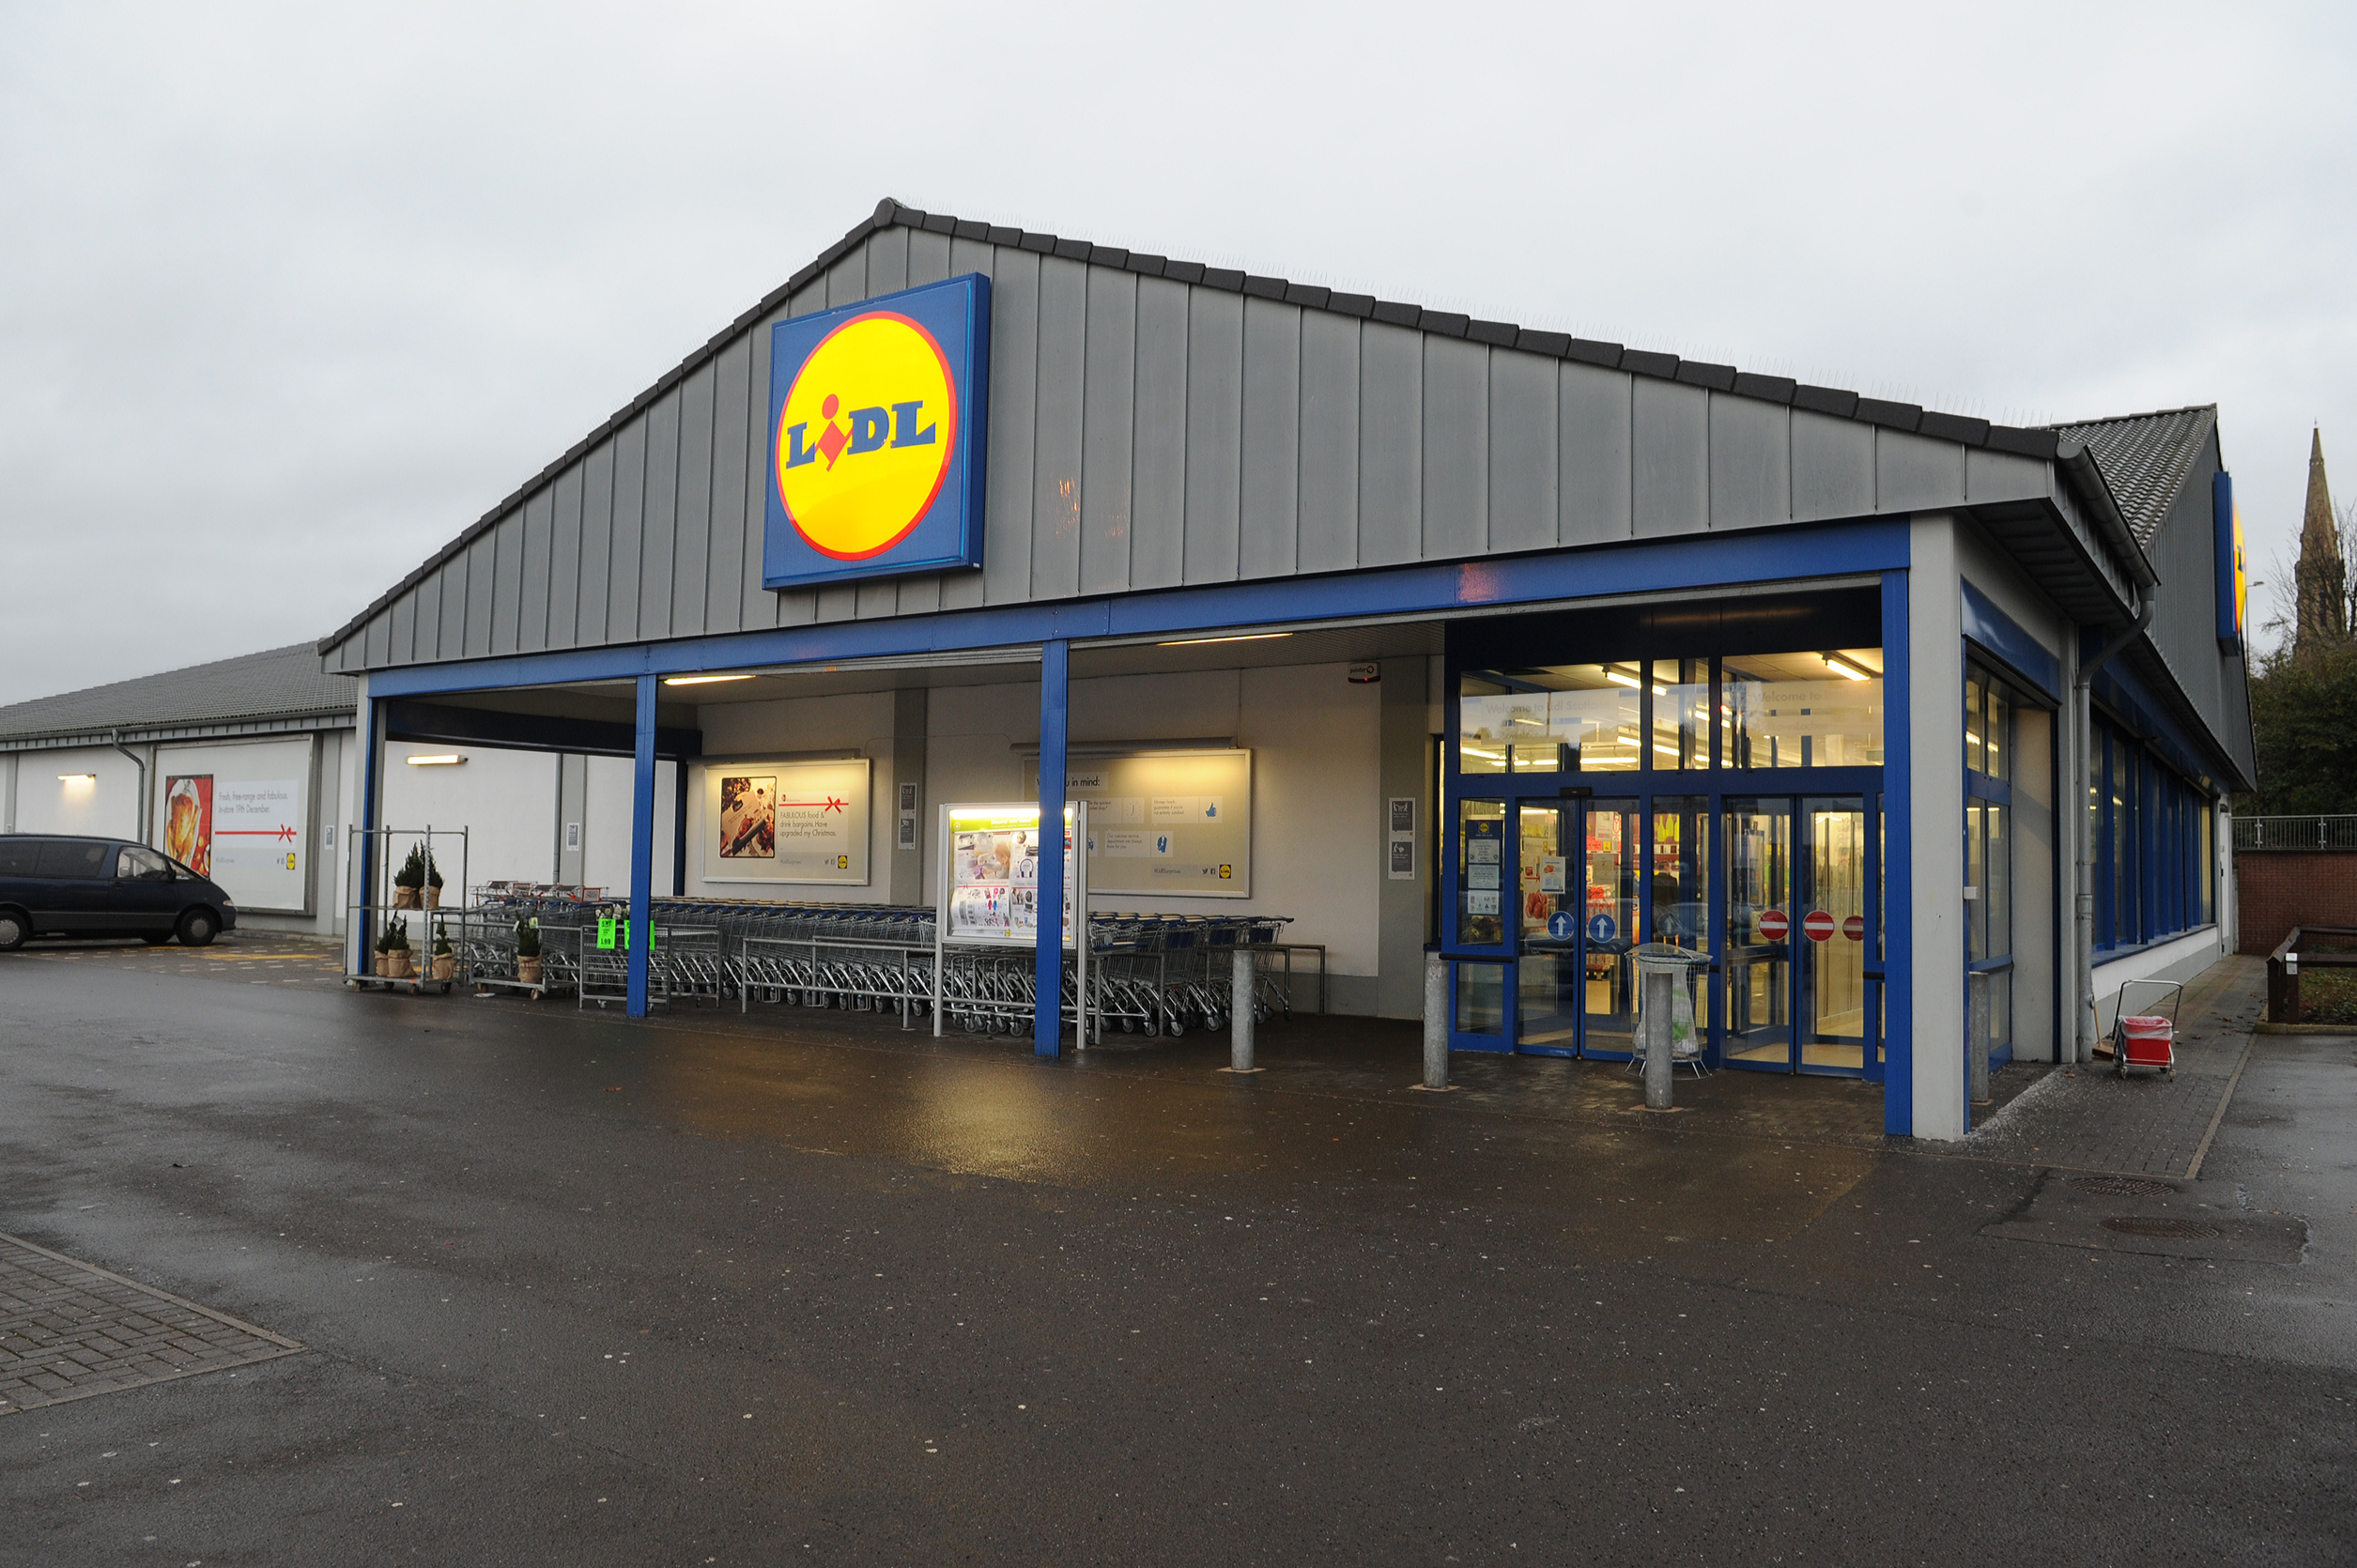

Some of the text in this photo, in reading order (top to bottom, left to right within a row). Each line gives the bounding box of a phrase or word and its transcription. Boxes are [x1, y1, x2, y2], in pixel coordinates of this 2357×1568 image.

[1810, 690, 1822, 700] to
[1487, 704, 1532, 714] Welcome
[1534, 703, 1544, 712] to
[1071, 777, 1079, 787] in
[1080, 776, 1101, 787] mind:
[233, 791, 255, 803] free-range
[256, 790, 266, 800] and
[779, 829, 803, 838] upgraded
